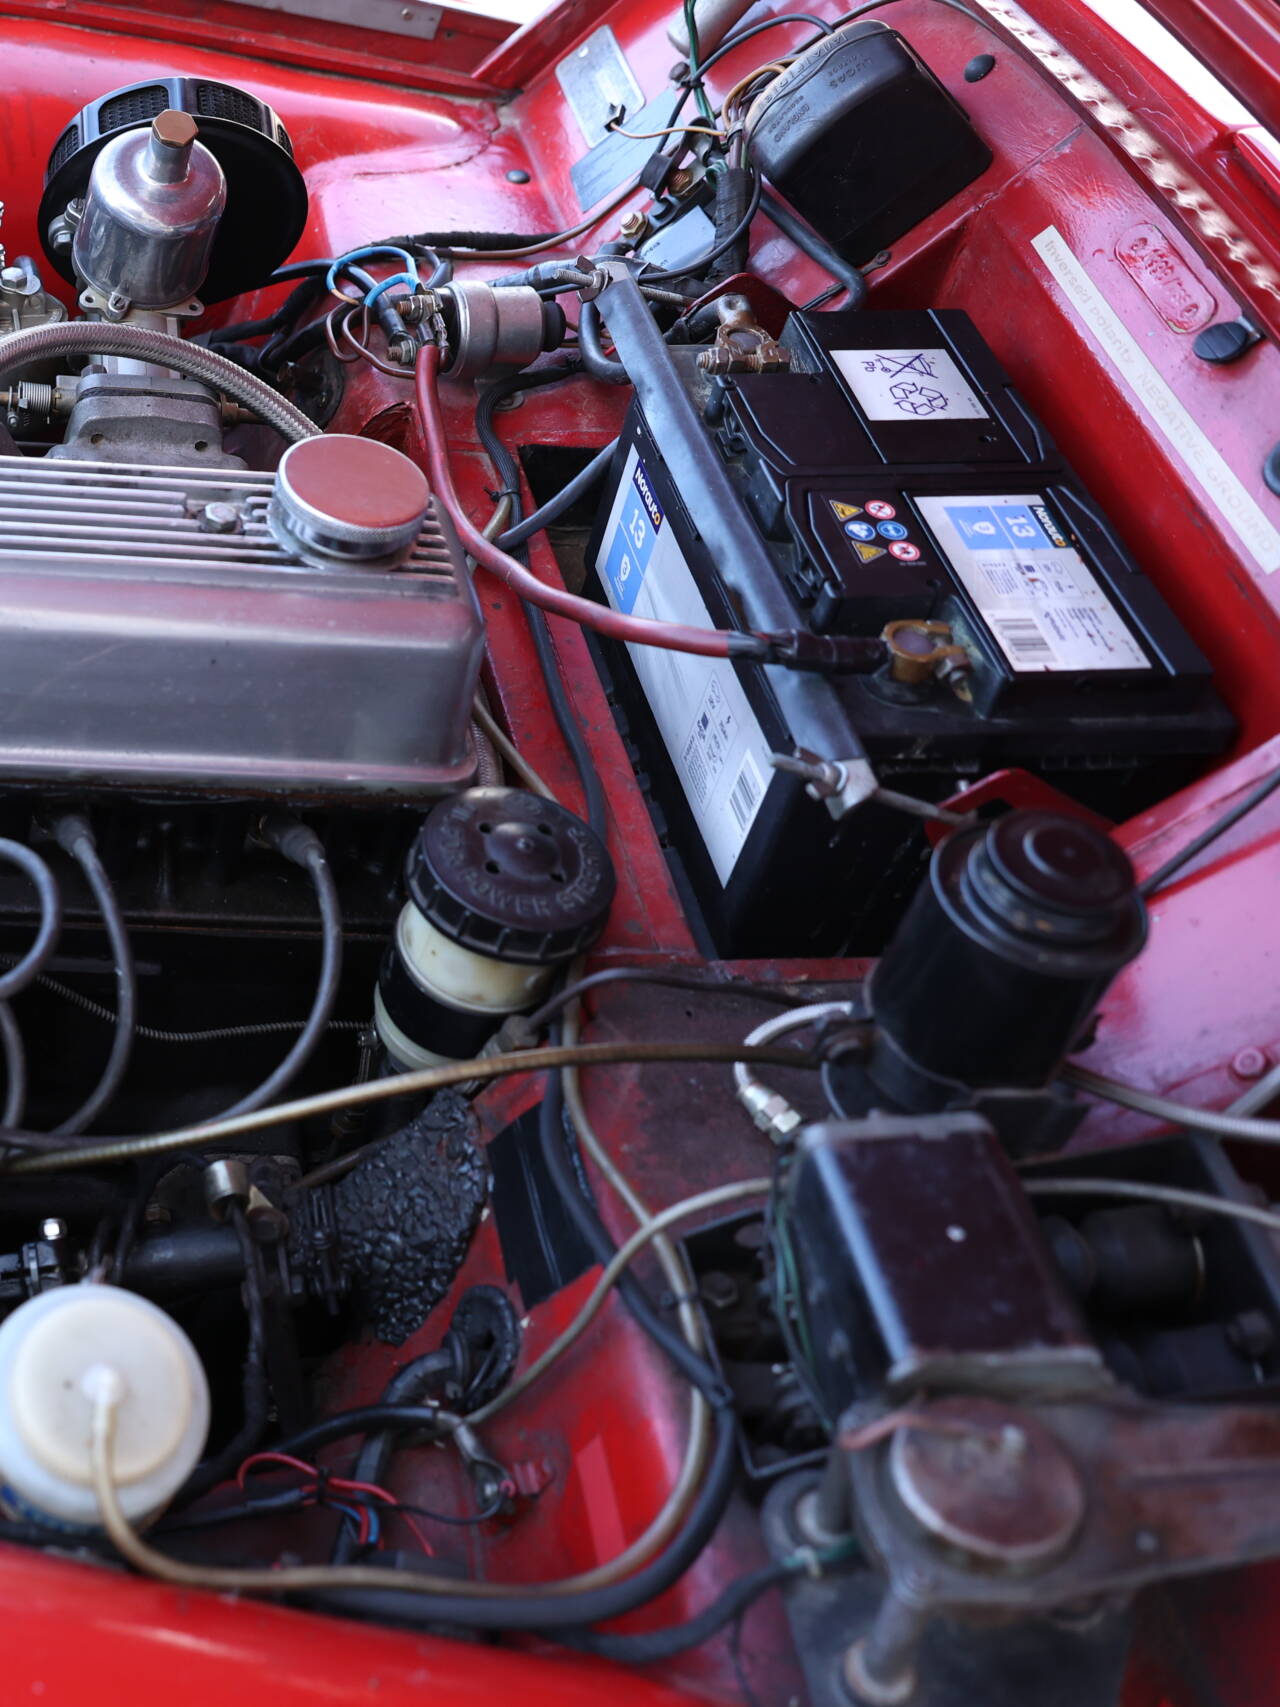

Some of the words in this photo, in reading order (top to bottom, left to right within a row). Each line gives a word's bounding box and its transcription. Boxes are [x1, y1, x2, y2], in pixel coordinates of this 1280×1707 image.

[861, 360, 877, 373] Pb
[1089, 306, 1136, 364] polarity
[1136, 373, 1207, 464] NEGATIVE
[1206, 466, 1276, 553] GROUND
[634, 466, 661, 526] Norauto
[629, 508, 646, 549] 13
[1005, 514, 1036, 539] 13
[1033, 506, 1067, 548] Norauto
[466, 869, 551, 918] POWER
[554, 825, 603, 912] STEERING
